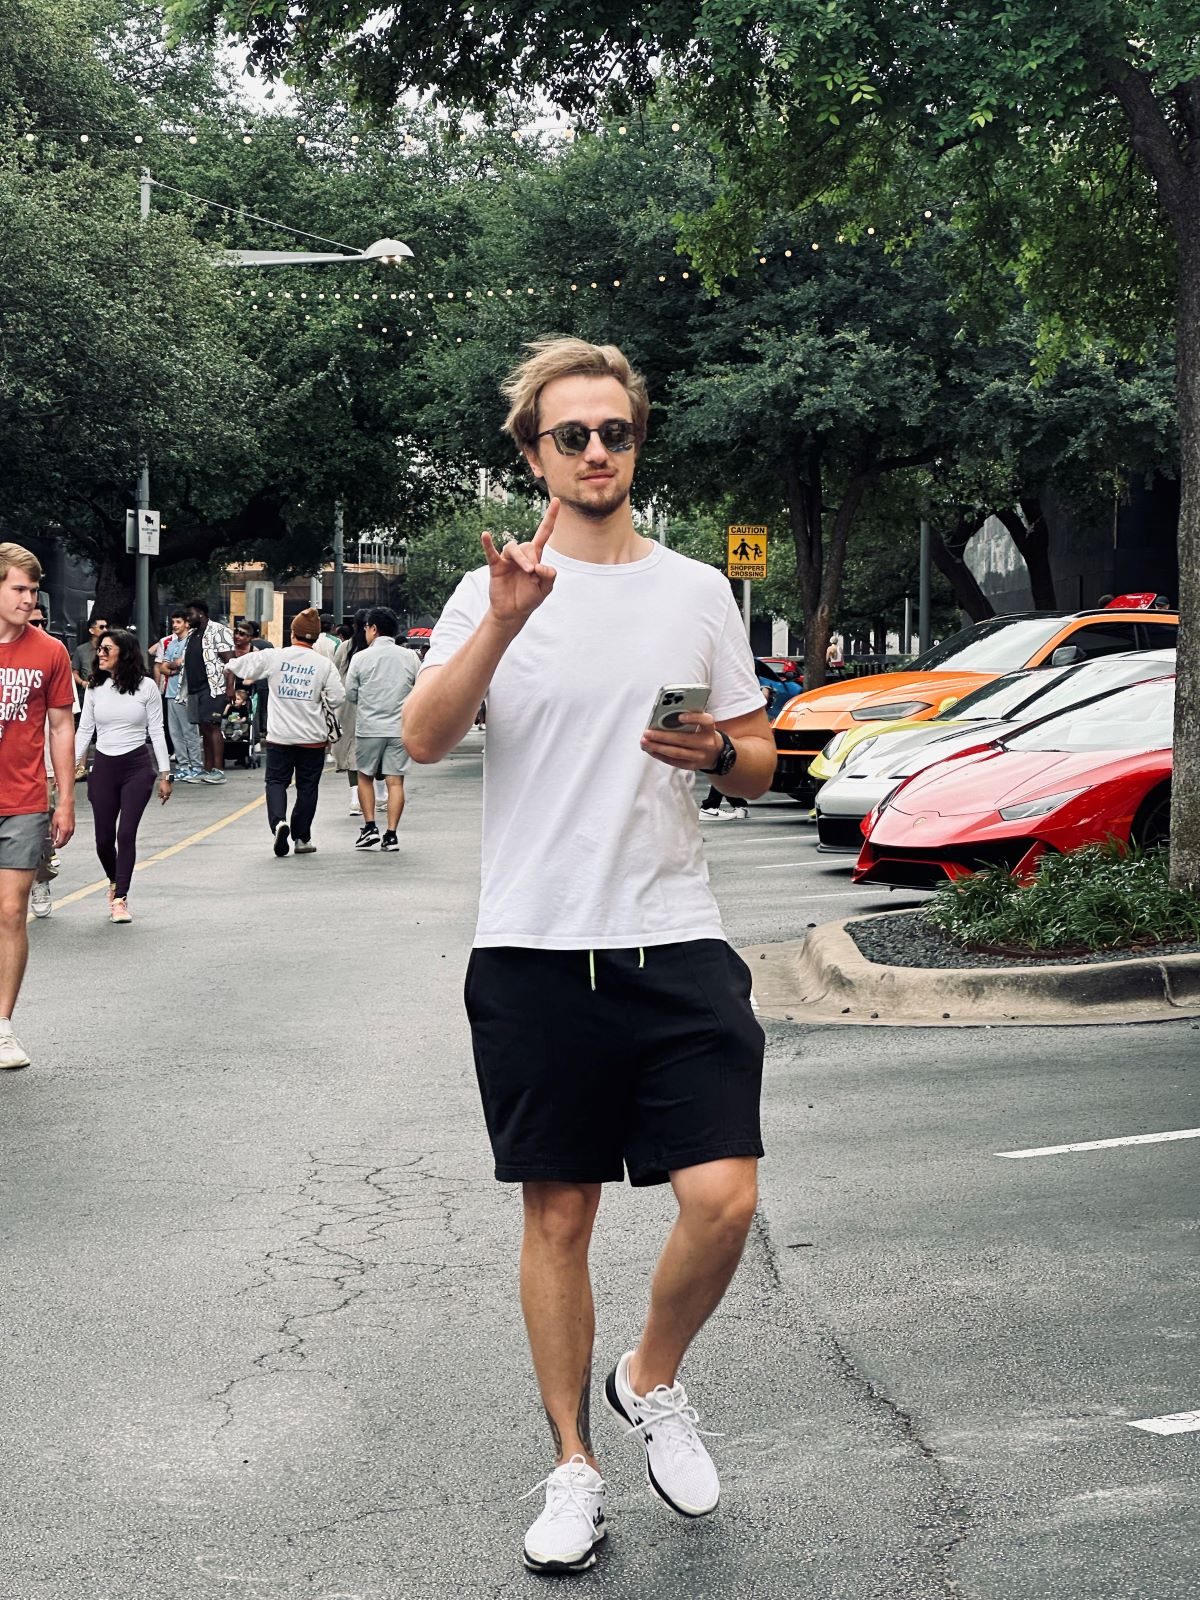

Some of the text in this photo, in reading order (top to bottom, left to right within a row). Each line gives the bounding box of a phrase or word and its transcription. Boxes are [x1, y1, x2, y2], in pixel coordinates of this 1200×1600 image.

[280, 661, 316, 675] Drink
[282, 674, 311, 686] More
[2, 685, 30, 703] FOR
[278, 685, 313, 699] Water!
